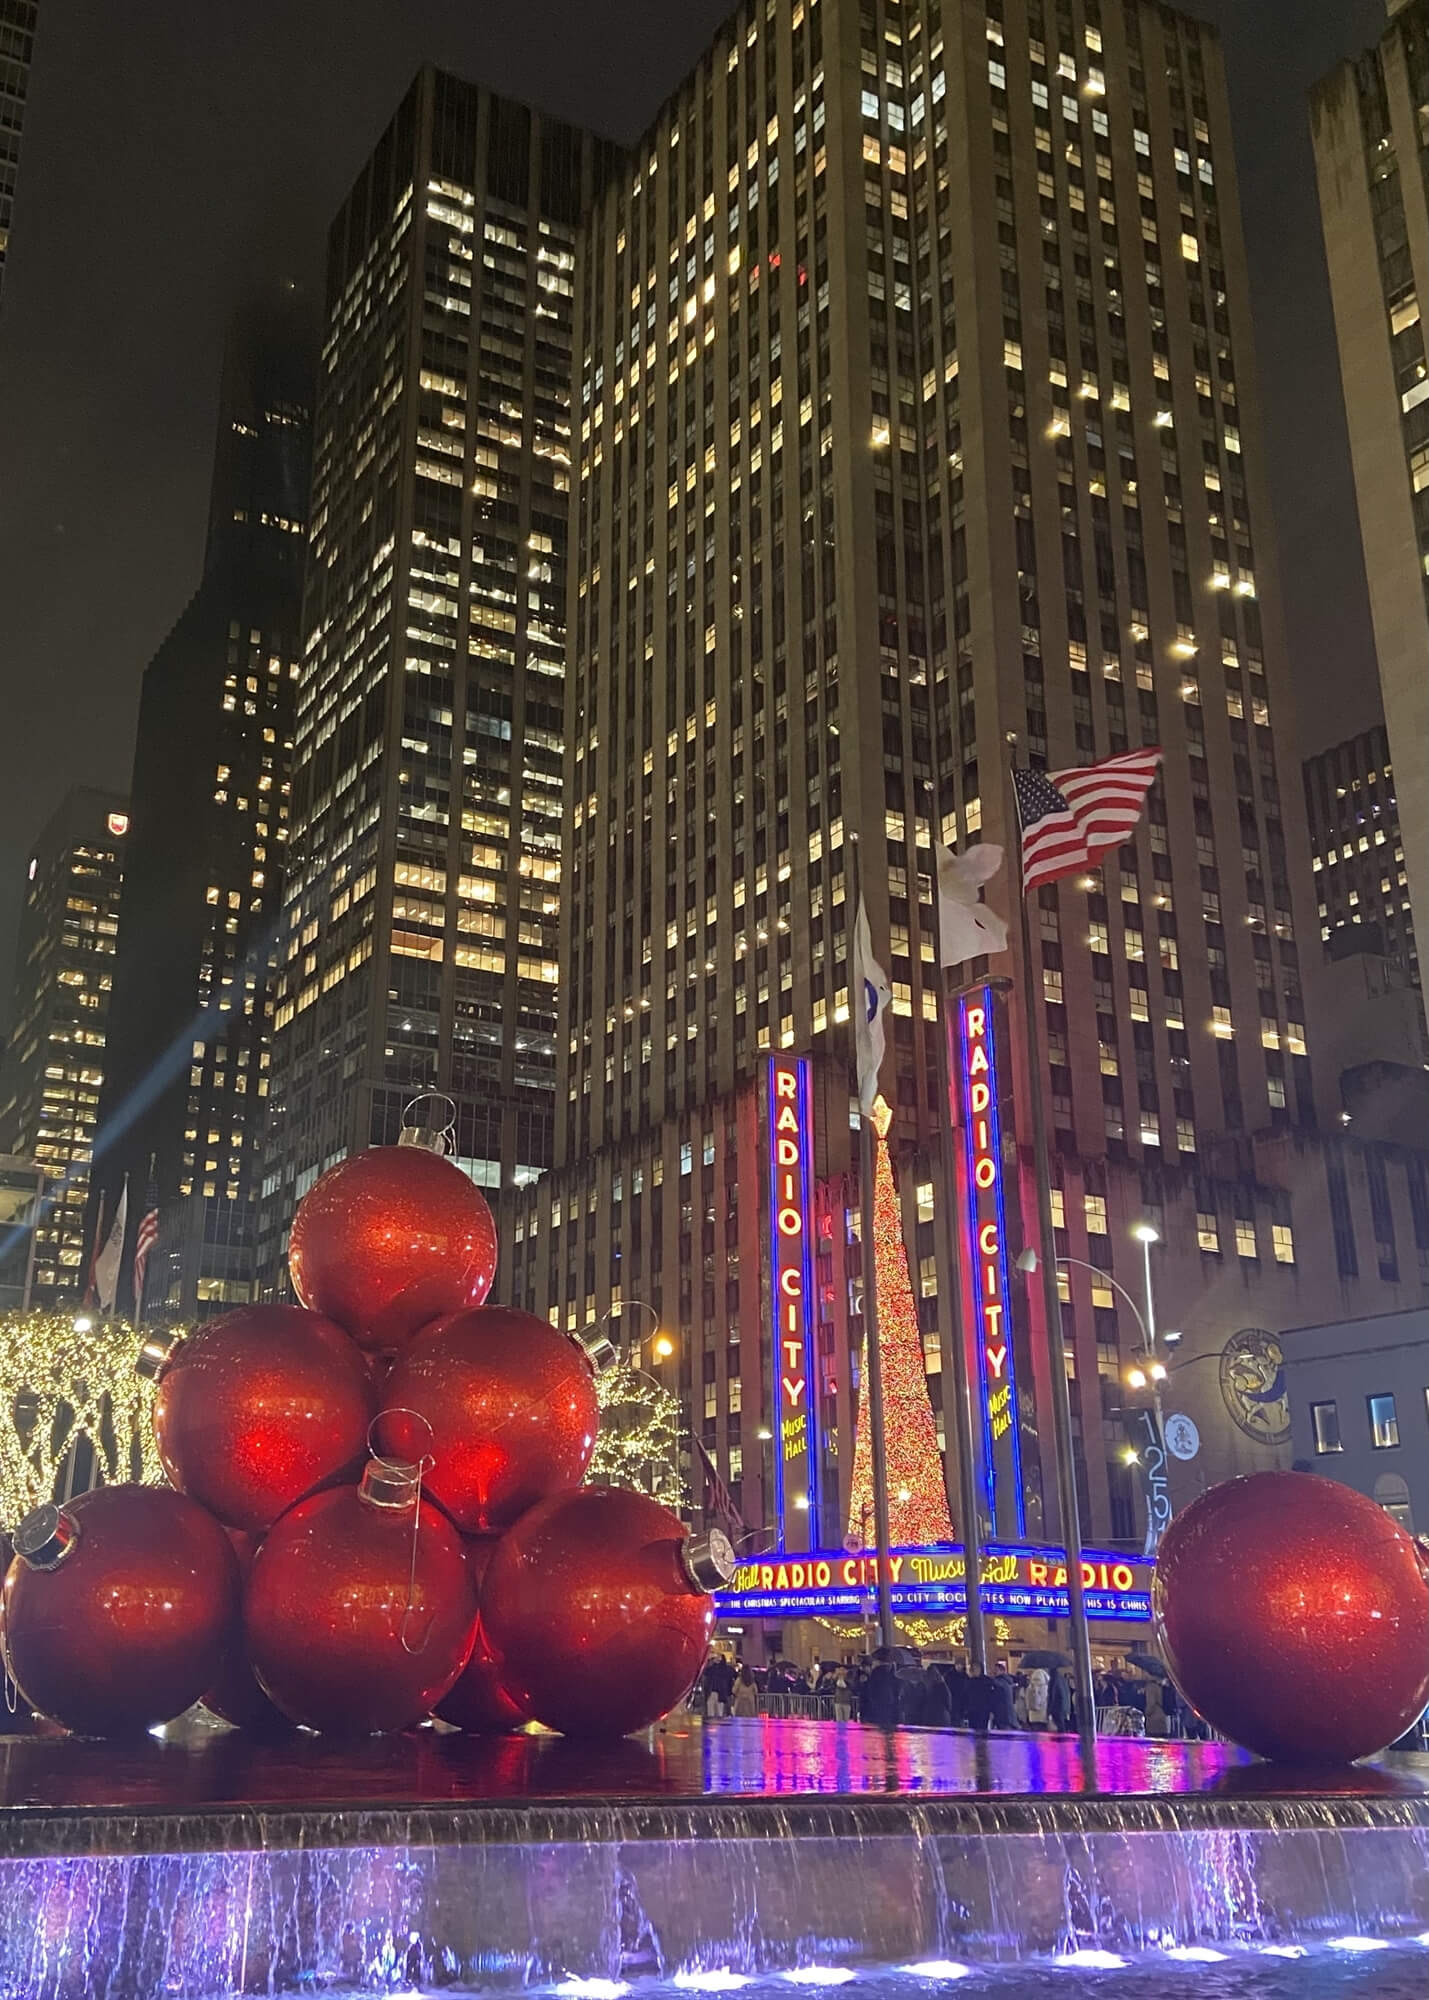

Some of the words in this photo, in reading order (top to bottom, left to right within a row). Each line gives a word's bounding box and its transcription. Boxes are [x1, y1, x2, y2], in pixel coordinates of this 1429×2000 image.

[967, 1007, 996, 1189] RADIO
[777, 1070, 802, 1236] RADIO
[980, 1223, 1007, 1379] CITY
[781, 1268, 805, 1407] CITY
[989, 1385, 1011, 1420] MUSIC
[781, 1414, 806, 1441] MUSIC
[993, 1410, 1012, 1440] HALL
[785, 1436, 807, 1461] HALL
[1138, 1410, 1169, 1531] 125
[761, 1561, 831, 1591] RADIO
[843, 1557, 904, 1586] CITY
[1030, 1562, 1134, 1592] RADIO
[907, 1592, 930, 1603] CITY
[1010, 1594, 1031, 1606] NOW
[1036, 1595, 1070, 1607] PLAYIN
[1121, 1601, 1150, 1612] CHRIS
